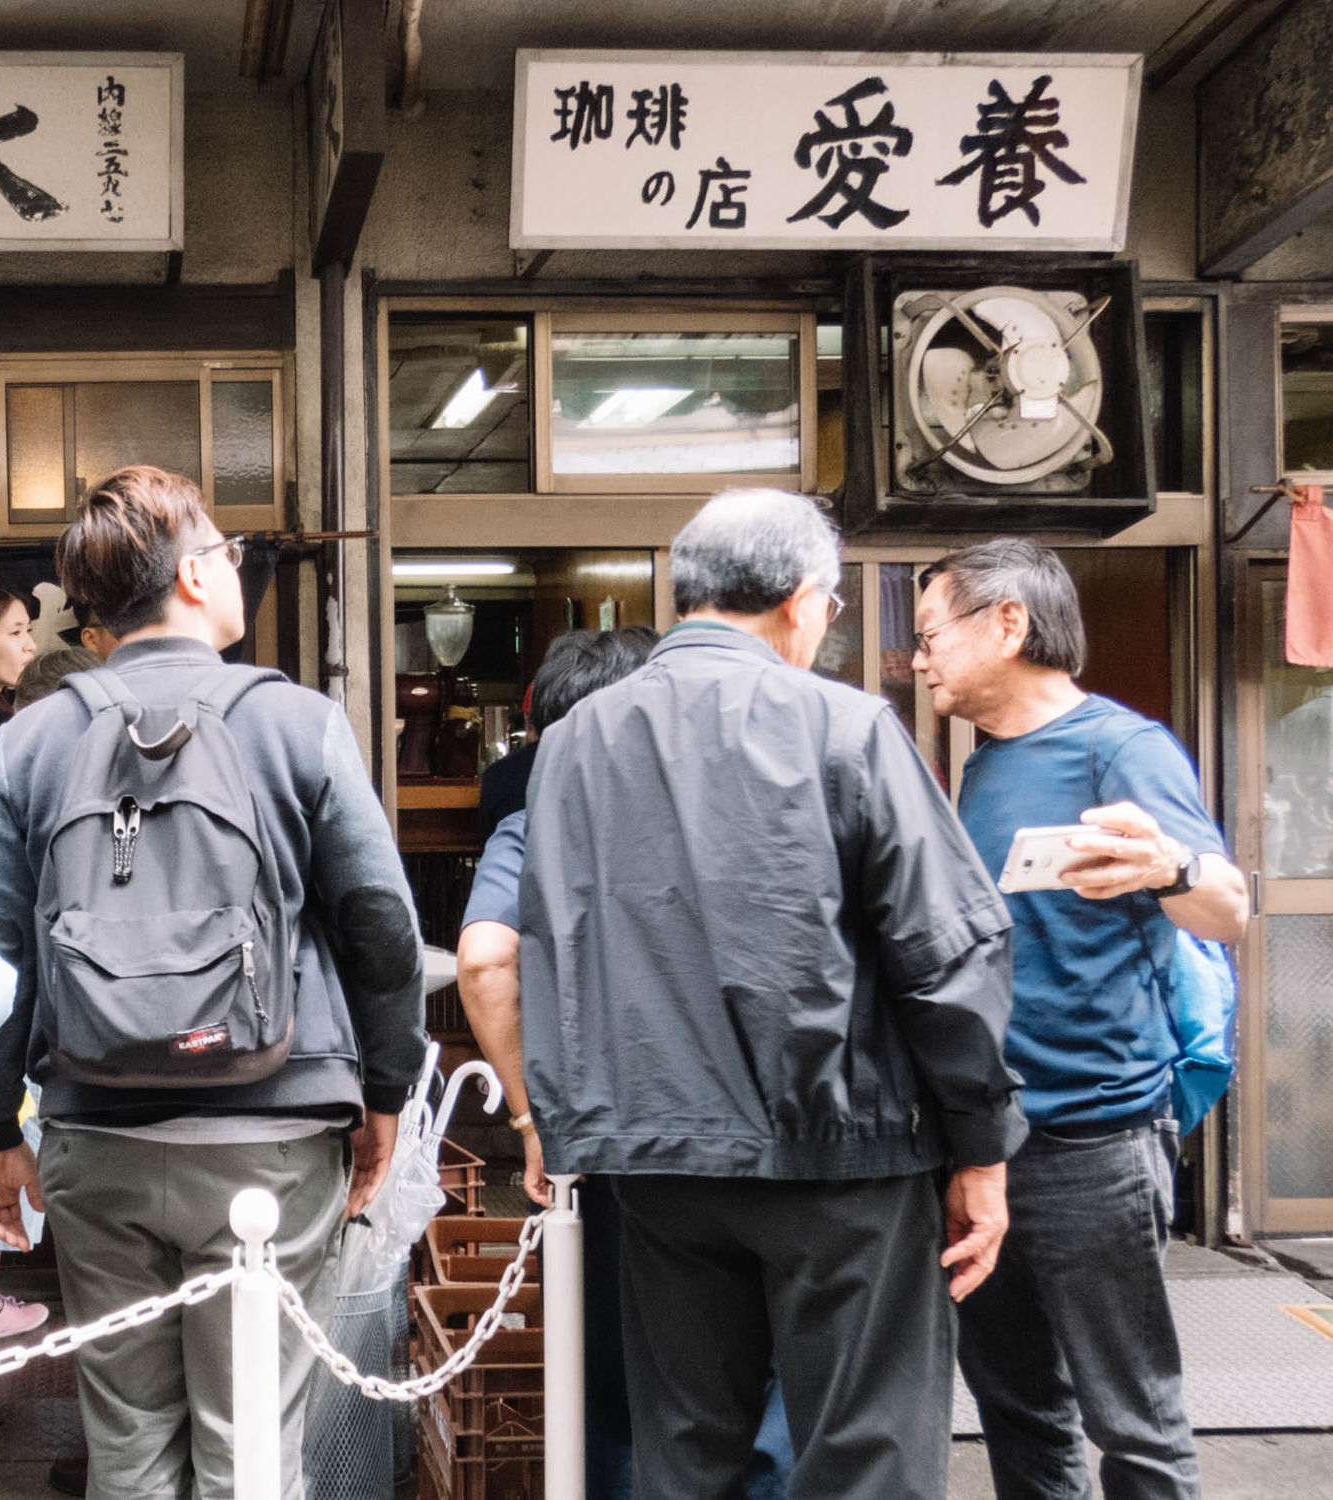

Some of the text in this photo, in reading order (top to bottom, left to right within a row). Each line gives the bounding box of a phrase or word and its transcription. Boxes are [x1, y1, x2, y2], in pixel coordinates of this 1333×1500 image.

[550, 80, 689, 151] 珈琲
[786, 75, 1087, 229] 愛養
[642, 156, 752, 230] の店
[178, 1031, 226, 1050] EASTPAK
